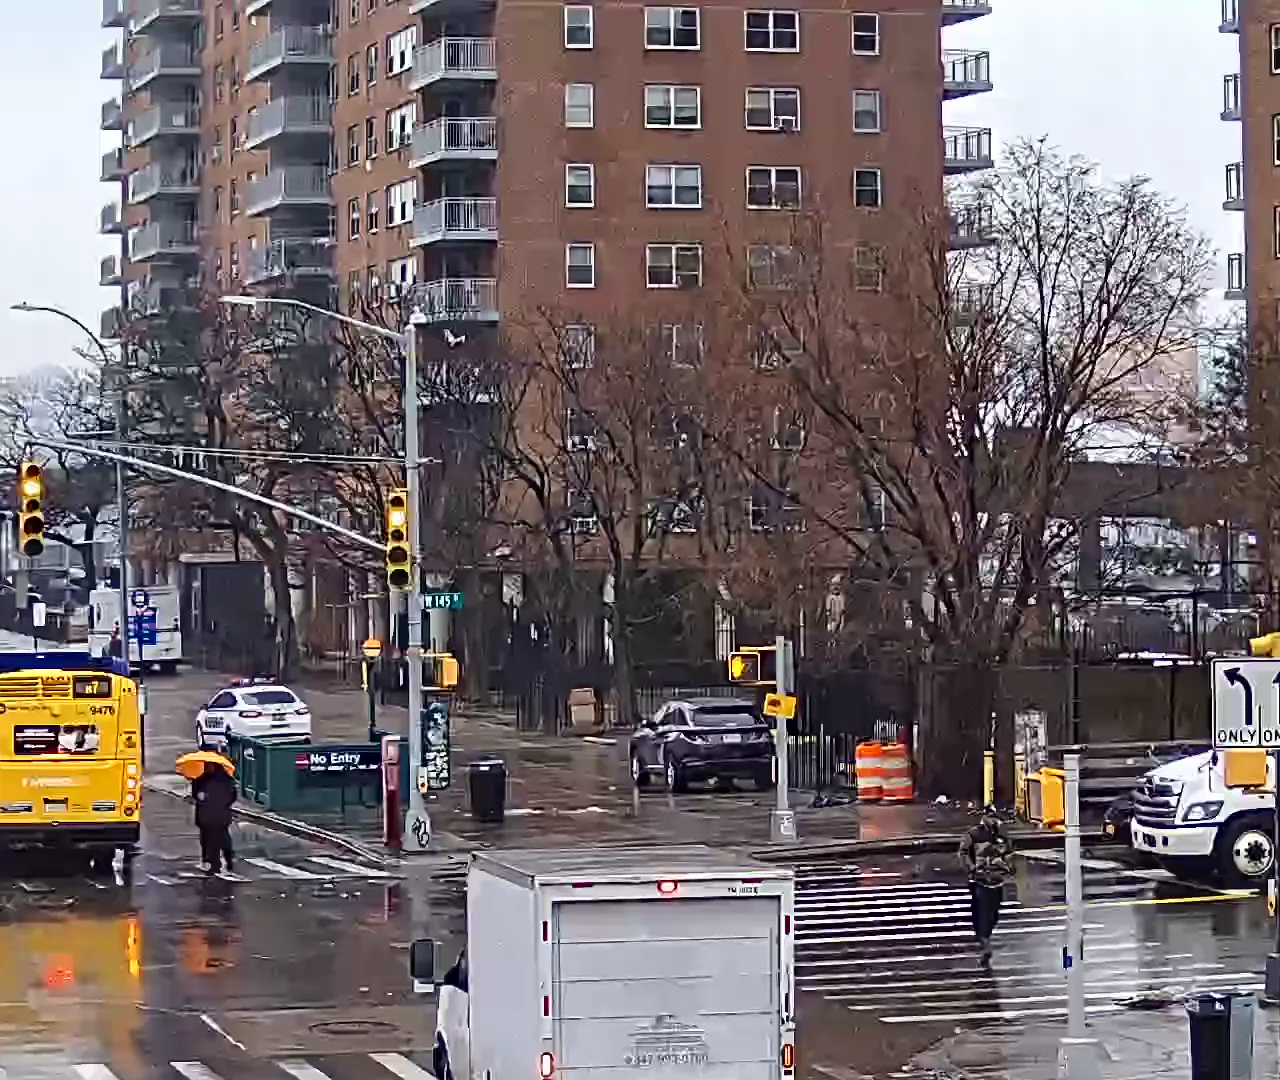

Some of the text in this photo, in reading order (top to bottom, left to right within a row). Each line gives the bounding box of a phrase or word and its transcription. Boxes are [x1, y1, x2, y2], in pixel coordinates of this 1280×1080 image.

[435, 595, 450, 608] 145
[1217, 729, 1256, 743] ONLY
[310, 752, 360, 765] No Entry
